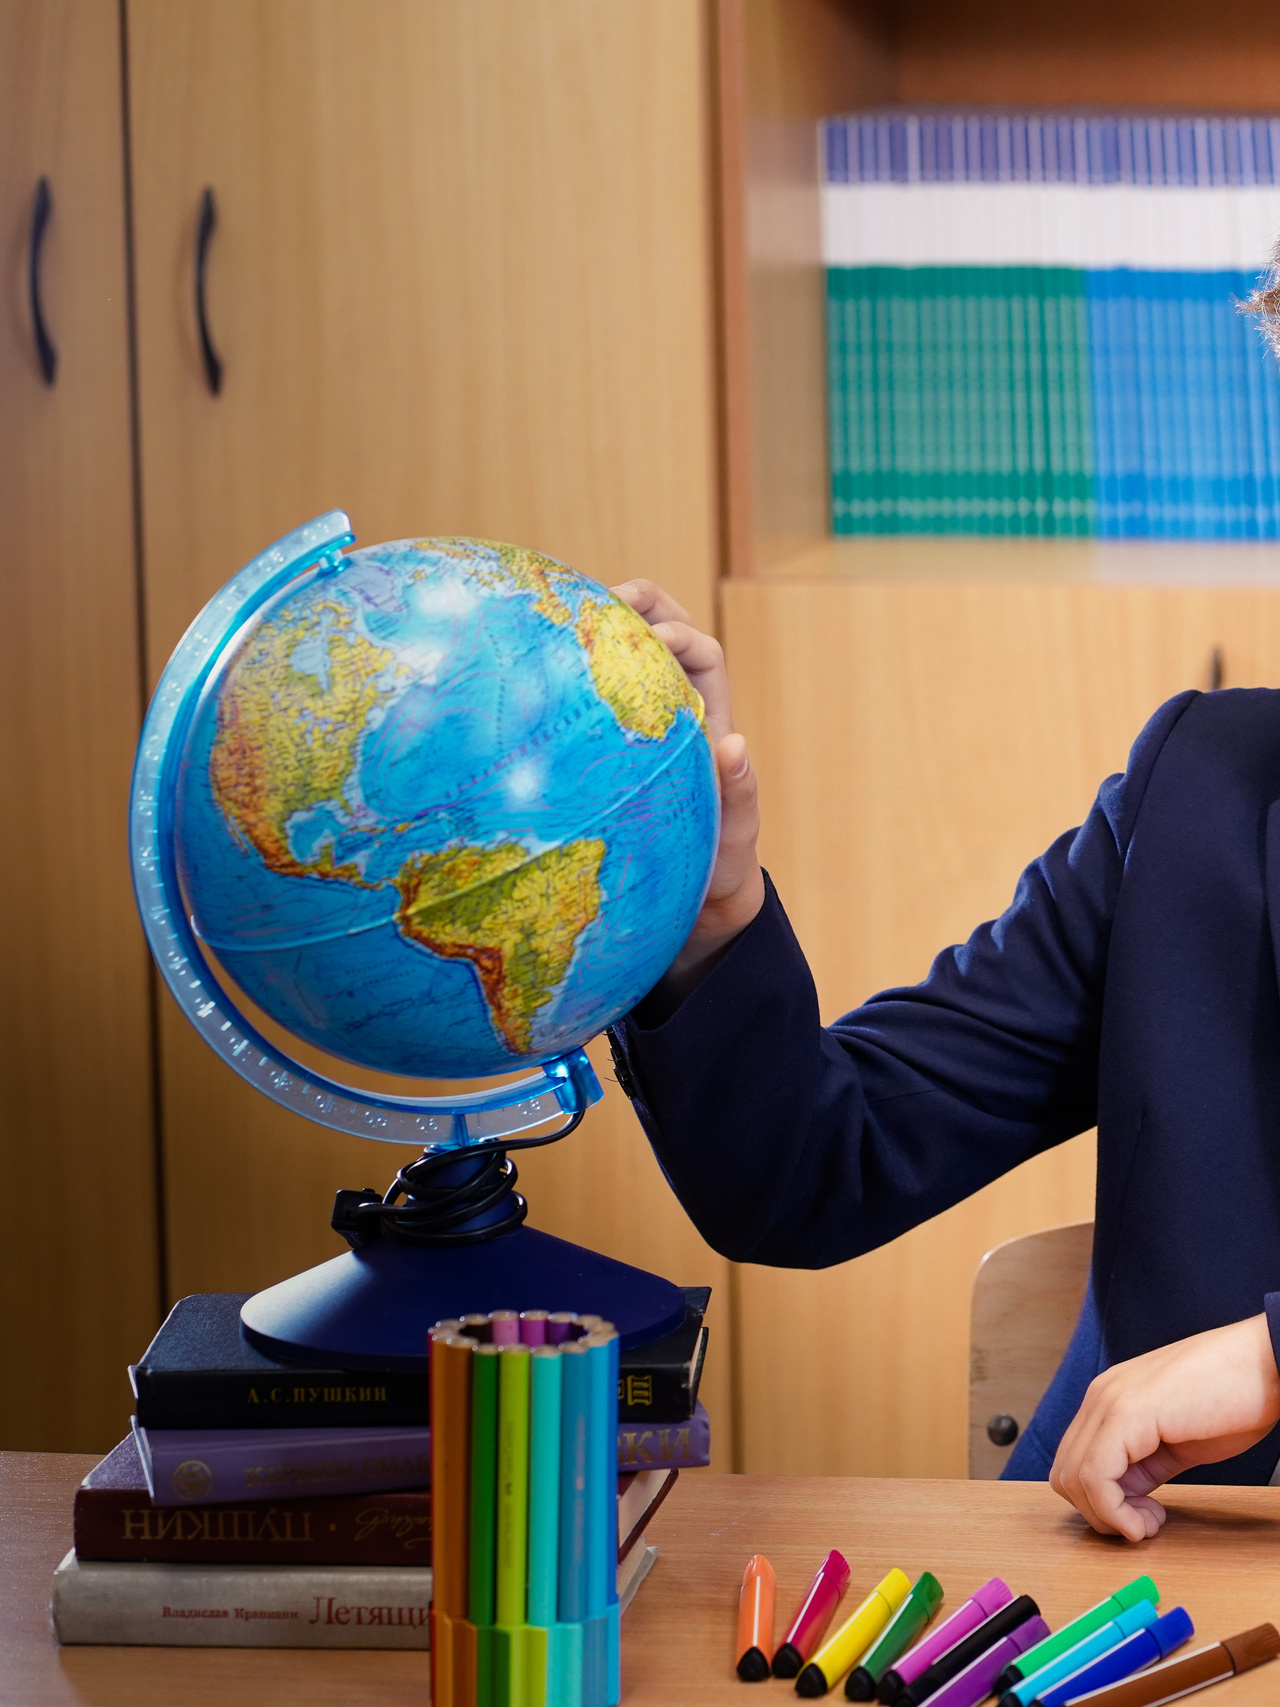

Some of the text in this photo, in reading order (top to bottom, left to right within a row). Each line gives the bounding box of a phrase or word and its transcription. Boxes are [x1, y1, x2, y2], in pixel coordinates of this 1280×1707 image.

[617, 1427, 693, 1465] КИ
[362, 1454, 431, 1479] СИЛЬ
[120, 1508, 314, 1542] ПУШКИН
[161, 1606, 230, 1620] Владислав
[308, 1596, 431, 1630] Летящи
